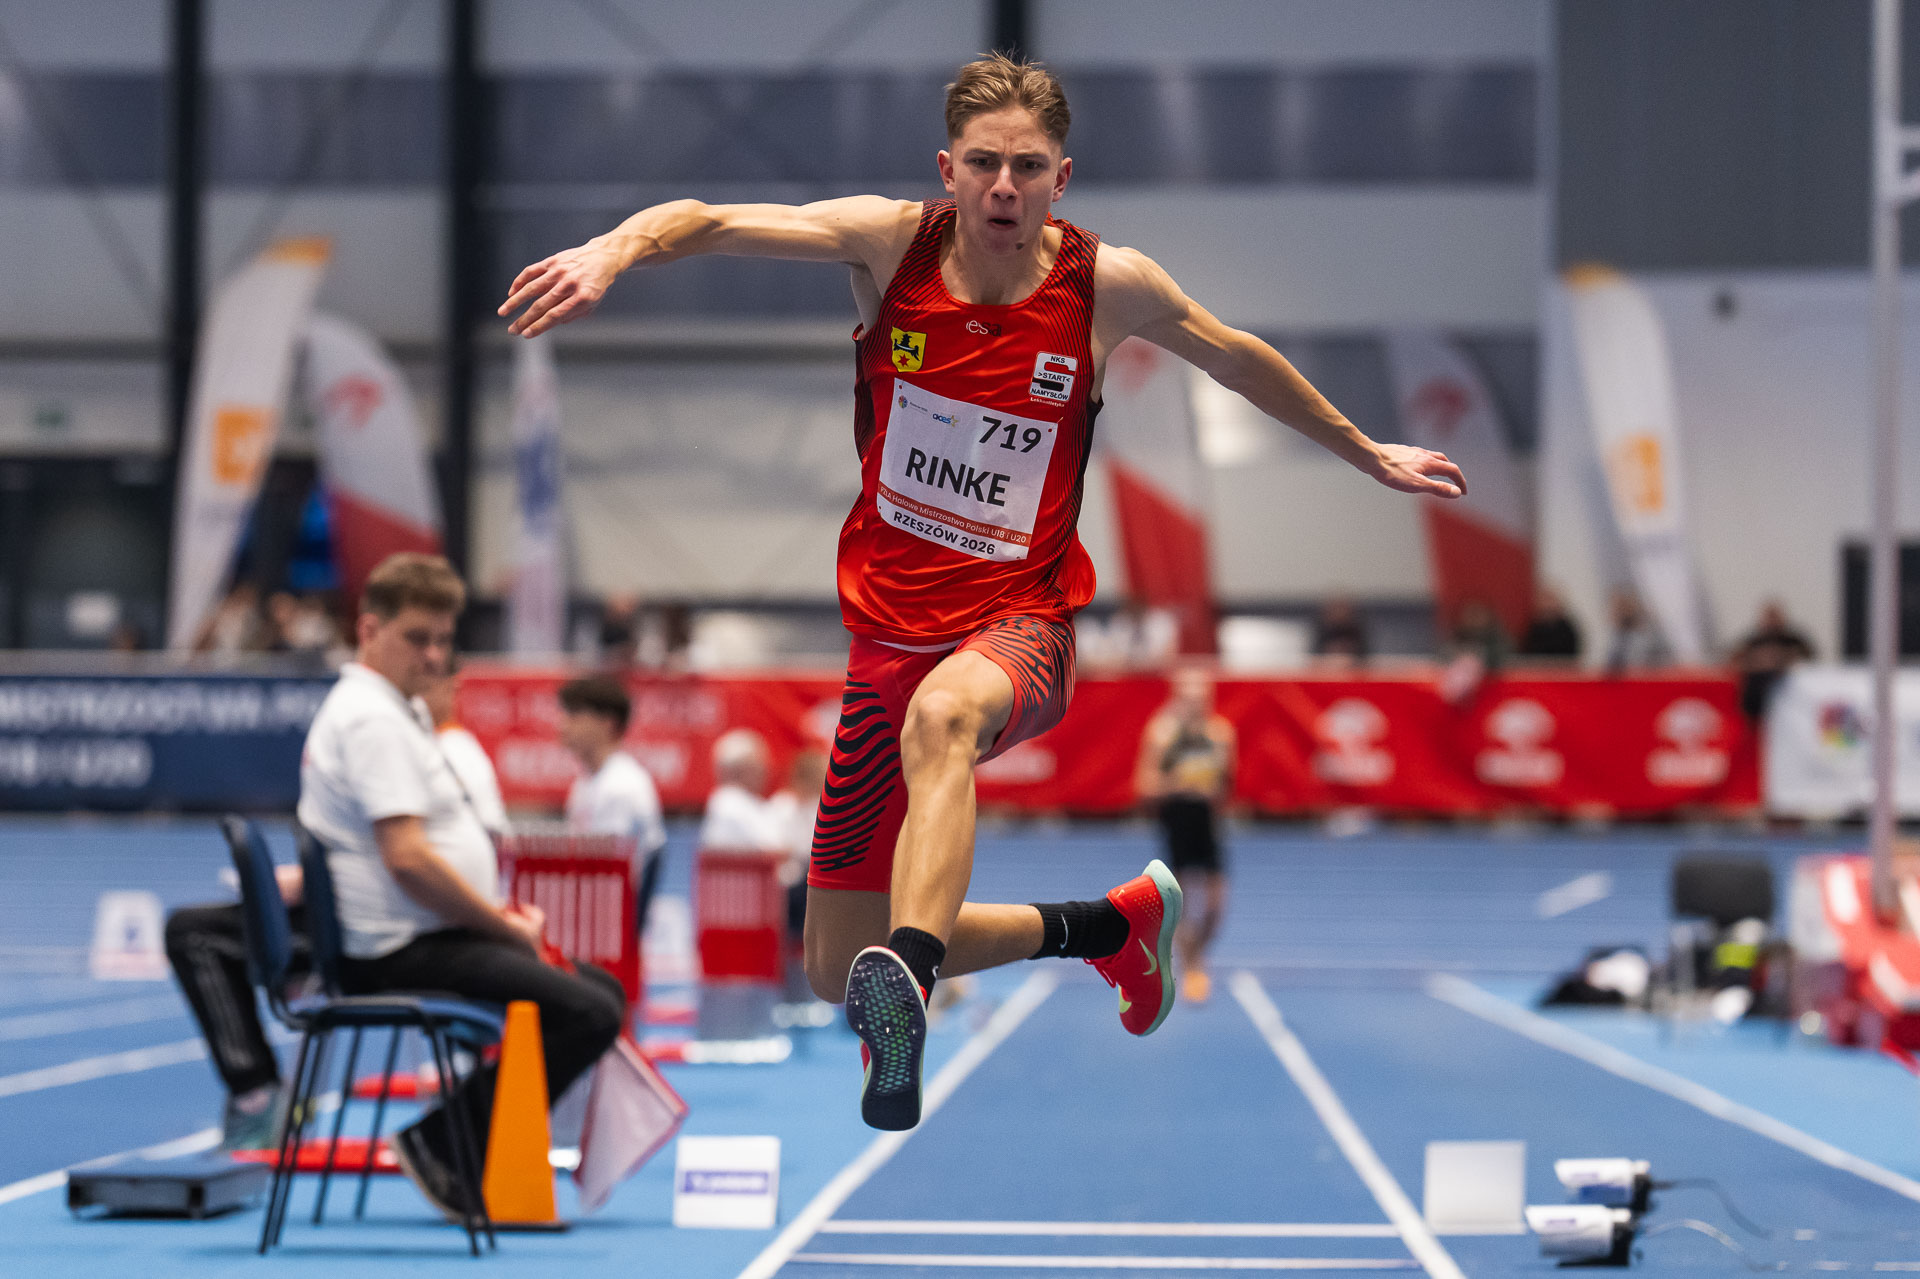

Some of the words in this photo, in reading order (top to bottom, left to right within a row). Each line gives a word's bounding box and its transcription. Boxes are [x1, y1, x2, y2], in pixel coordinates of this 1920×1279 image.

[1050, 355, 1066, 364] NKS
[1031, 388, 1069, 400] NAMYSŁÓW
[978, 415, 1042, 454] 719
[905, 446, 1011, 507] RINKE
[892, 495, 919, 512] Halowe
[919, 506, 965, 528] Mistrzostwa
[965, 522, 990, 535] Polski
[991, 529, 1006, 539] U18
[1010, 534, 1027, 544] U20
[893, 511, 959, 544] RZESZÓW
[959, 536, 996, 555] 2026
